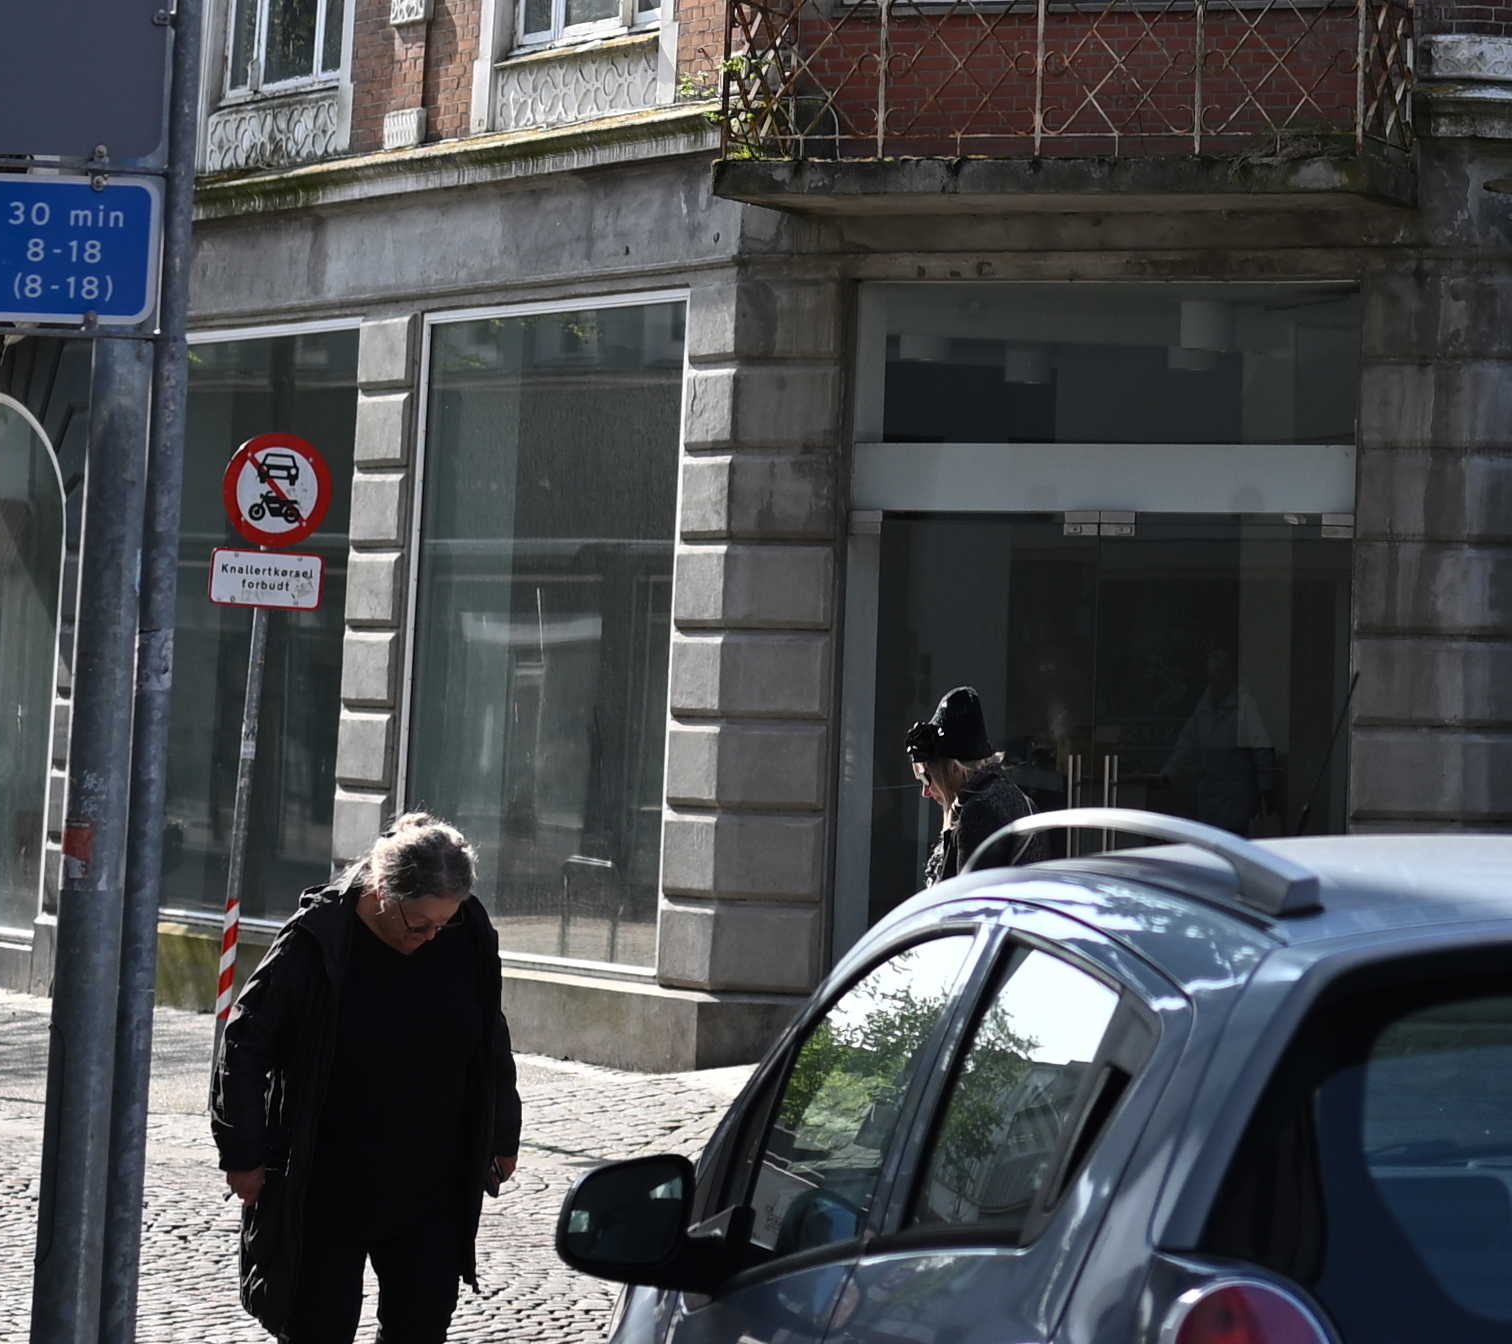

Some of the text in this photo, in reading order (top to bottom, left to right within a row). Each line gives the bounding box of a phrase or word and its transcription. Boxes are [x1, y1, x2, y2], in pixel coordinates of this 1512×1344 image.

[8, 201, 124, 228] 30 min
[221, 563, 313, 580] Knallertkørsel
[241, 578, 290, 592] forbudt
